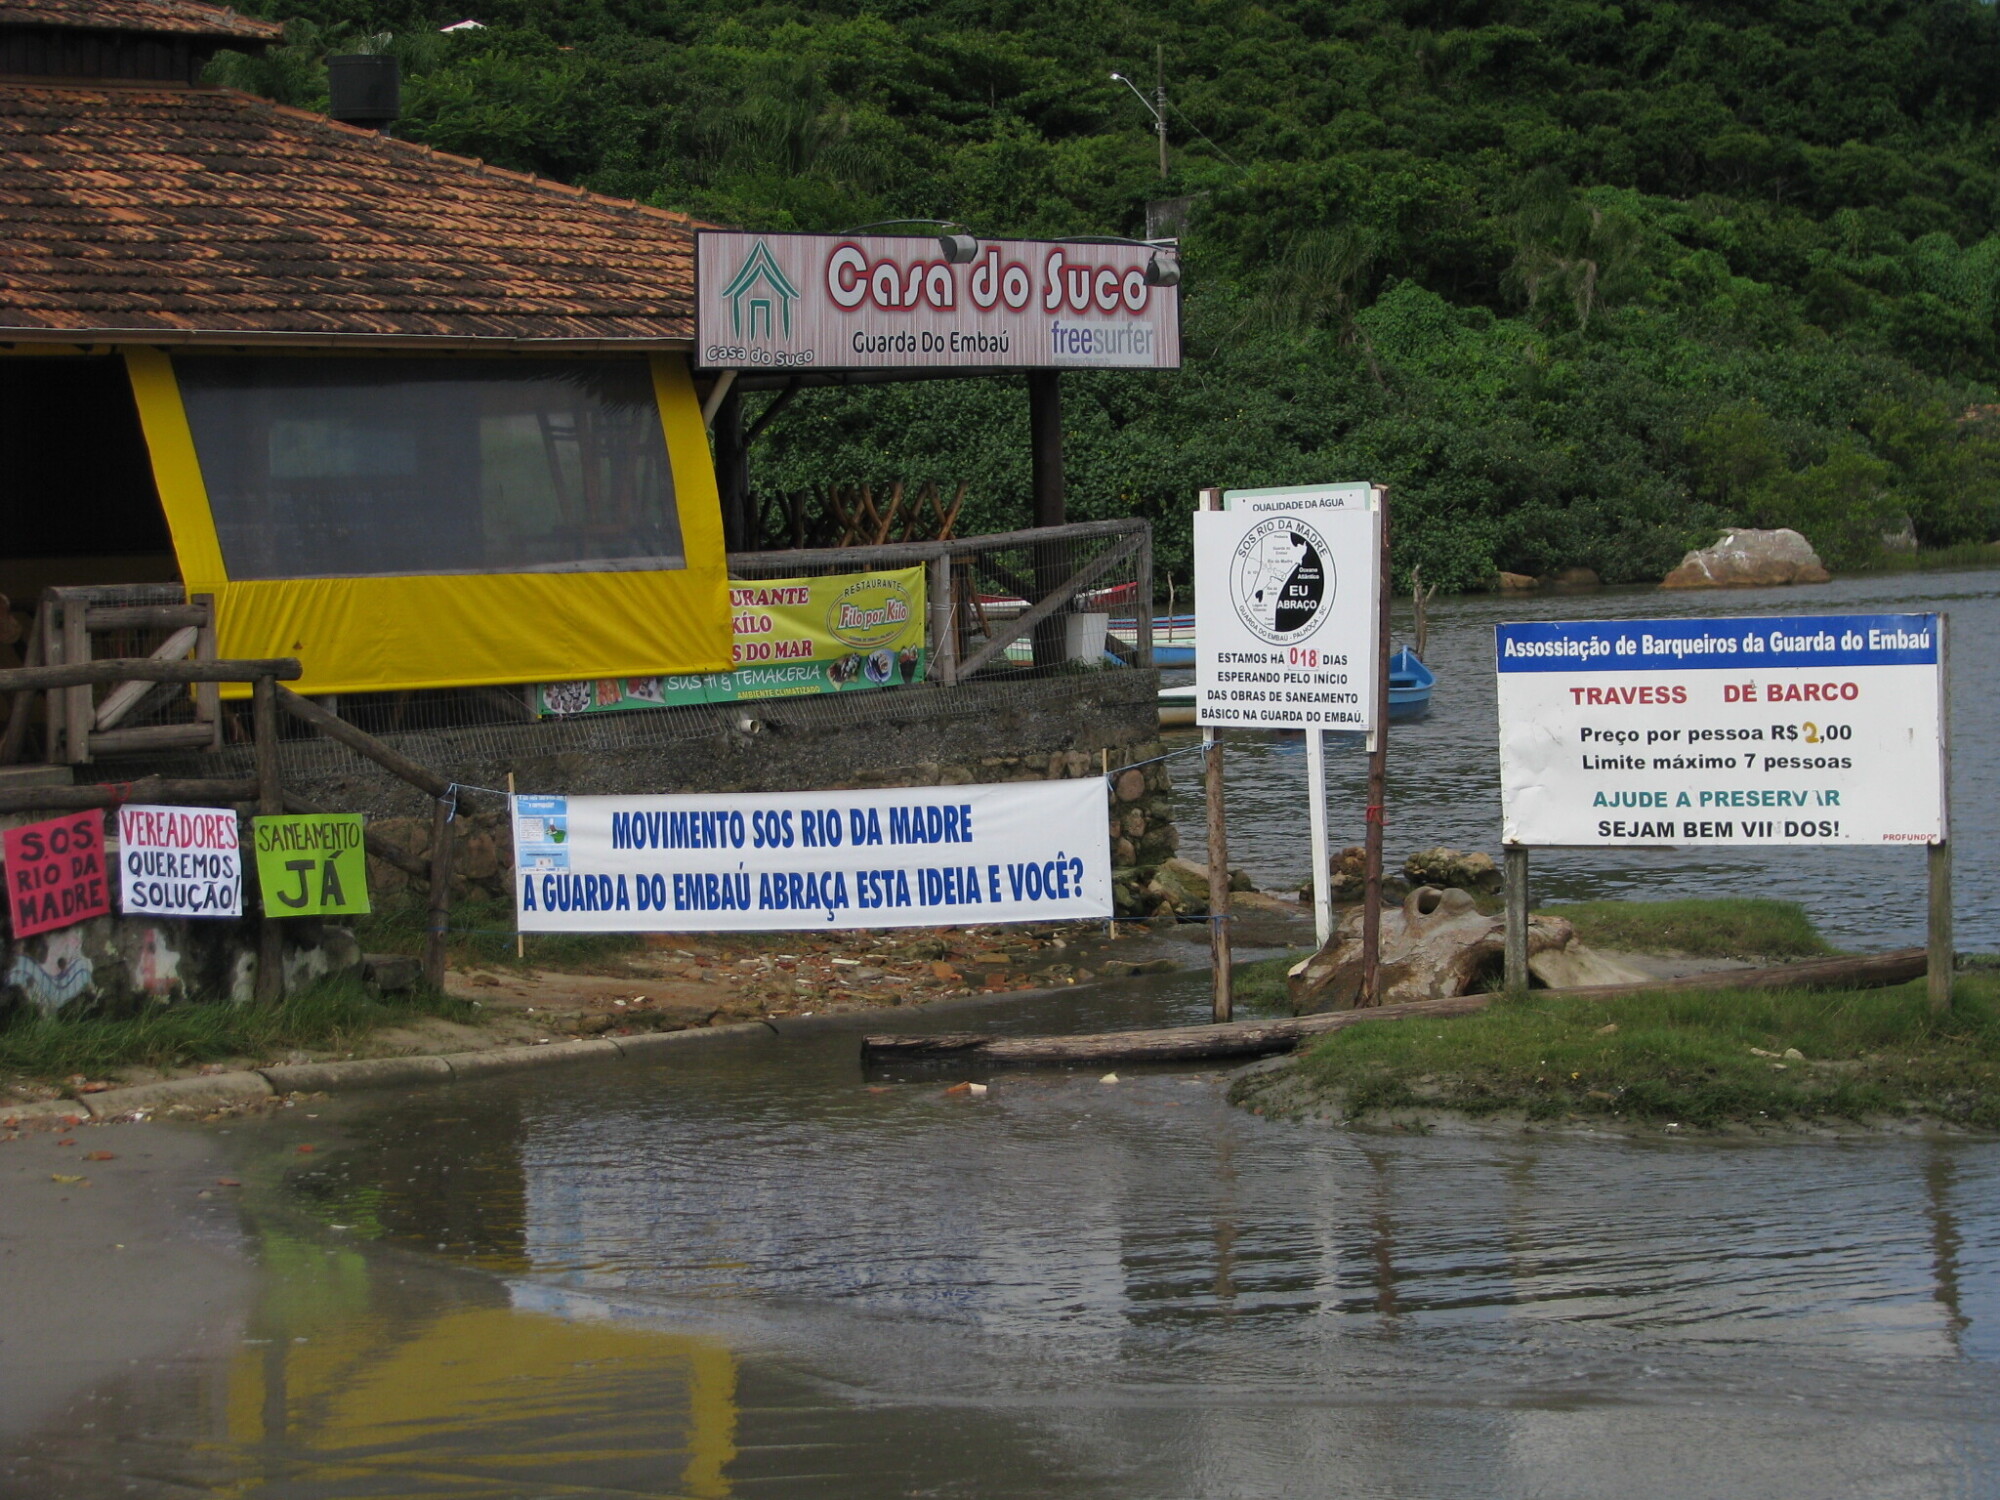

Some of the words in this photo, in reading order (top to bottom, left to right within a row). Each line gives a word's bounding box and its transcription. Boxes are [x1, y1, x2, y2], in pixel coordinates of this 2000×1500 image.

[827, 242, 956, 311] Casa
[969, 246, 1031, 312] do
[1044, 248, 1149, 314] Suco
[852, 331, 917, 354] Guarda
[922, 332, 945, 354] Do
[950, 330, 1009, 354] Embaú
[1051, 320, 1153, 354] freesurfer
[706, 345, 747, 361] Casa
[750, 347, 772, 364] do
[775, 350, 814, 366] Suco
[1304, 500, 1318, 509] DA
[1319, 498, 1344, 508] ÁGUA
[1238, 534, 1257, 558] SOS
[1256, 521, 1275, 536] RIO
[1277, 519, 1293, 530] DA
[1295, 522, 1328, 558] MADRE
[844, 579, 902, 597] RESTAURANTE
[1289, 584, 1309, 597] EU
[838, 603, 863, 629] Filo
[863, 608, 885, 631] por
[885, 598, 908, 622] Kilo
[1277, 599, 1317, 612] ABRAÇO
[1239, 604, 1259, 631] GUARDA
[1258, 628, 1267, 638] DO
[1318, 605, 1327, 616] SC
[746, 642, 771, 661] DO
[775, 640, 813, 659] MAR
[1504, 636, 1610, 661] Assossiação
[1615, 635, 1637, 655] de
[1642, 633, 1738, 659] Barqueiros
[1742, 632, 1764, 653] da
[1769, 631, 1835, 652] Guarda
[1841, 630, 1863, 651] do
[1868, 628, 1929, 650] Embaú
[1218, 652, 1267, 664] ESTAMOS
[1270, 653, 1285, 664] HÁ
[1289, 647, 1317, 668] 018
[1322, 655, 1348, 666] DIAS
[733, 665, 821, 686] TEMAKERIA
[1218, 672, 1280, 684] ESPERANDO
[1283, 673, 1311, 684] PELO
[1314, 671, 1348, 685] INÍCIO
[737, 689, 775, 699] AMBIENTE
[774, 685, 822, 697] CLIMATIZADO
[1207, 689, 1227, 701] DAS
[1230, 690, 1266, 702] OBRAS
[1269, 691, 1282, 702] DE
[1285, 691, 1358, 704] SANEAMENTO
[1724, 684, 1757, 703] DE
[1767, 682, 1859, 702] BARCO
[1201, 706, 1240, 720] BÁSICO
[1243, 709, 1257, 720] NA
[1260, 709, 1303, 722] GUARDA
[1306, 711, 1321, 722] DO
[1324, 710, 1364, 723] EMBAÚ.
[1580, 727, 1640, 745] Preço
[1647, 730, 1681, 745] por
[1688, 728, 1764, 744] pessoa
[1582, 755, 1646, 770] Limite
[1653, 753, 1737, 770] máximo
[1744, 753, 1756, 769] 7
[1764, 755, 1852, 772] pessoas
[1593, 791, 1668, 808] AJUDE
[1675, 791, 1692, 808] A
[121, 810, 238, 850] VEREADORES
[259, 822, 360, 852] SANEAMENTO
[612, 810, 745, 849] MOVIMENTO
[752, 809, 795, 849] SOS
[801, 808, 843, 848] RIO
[850, 807, 884, 846] DA
[889, 804, 973, 845] MADRE
[1598, 820, 1675, 838] SEJAM
[1683, 821, 1733, 838] BEM
[16, 863, 61, 893] RIO
[71, 853, 99, 879] DA
[128, 851, 234, 878] QUEREMOS
[277, 850, 346, 909] JÁ
[523, 874, 537, 911] A
[542, 873, 631, 912] GUARDA
[636, 872, 667, 911] DO
[673, 861, 751, 911] EMBAÚ
[758, 871, 849, 922] ABRAÇA
[856, 869, 911, 909] ESTA
[917, 866, 981, 906] IDEIA
[988, 864, 1002, 903] E
[1008, 851, 1084, 902] VOCÊ?
[18, 877, 104, 928] MADRE
[131, 874, 241, 915] SOLUÇÃO!
